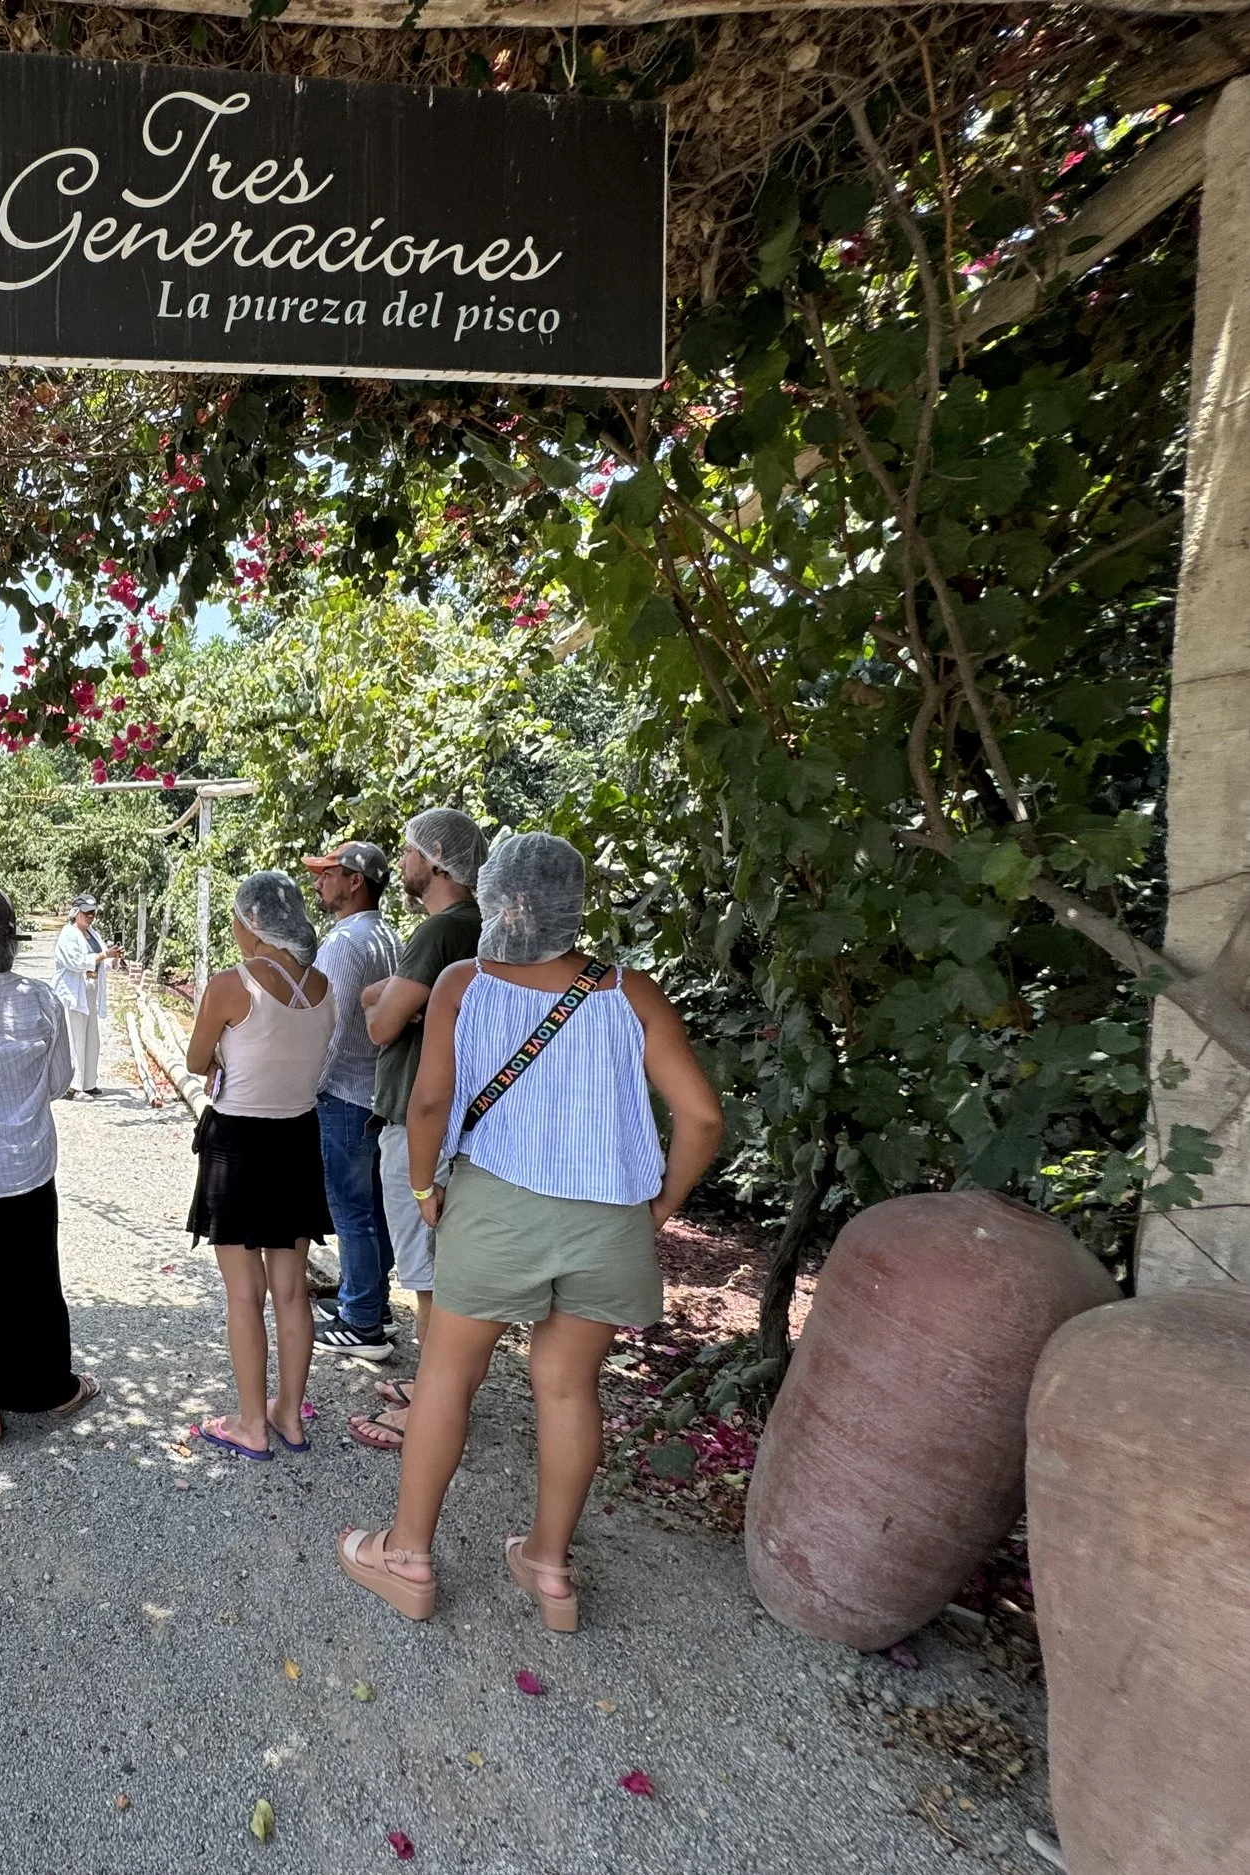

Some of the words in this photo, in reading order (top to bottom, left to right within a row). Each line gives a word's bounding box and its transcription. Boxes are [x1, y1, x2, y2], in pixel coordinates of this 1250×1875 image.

[122, 91, 334, 208] Tres
[156, 280, 211, 319] La
[224, 291, 366, 333] pureza
[382, 290, 443, 328] del
[454, 294, 560, 342] pisco
[550, 988, 584, 1023] LOVE
[524, 1021, 558, 1055] LOVE
[497, 1053, 530, 1086] LOVE
[476, 1081, 504, 1111] LOVE
